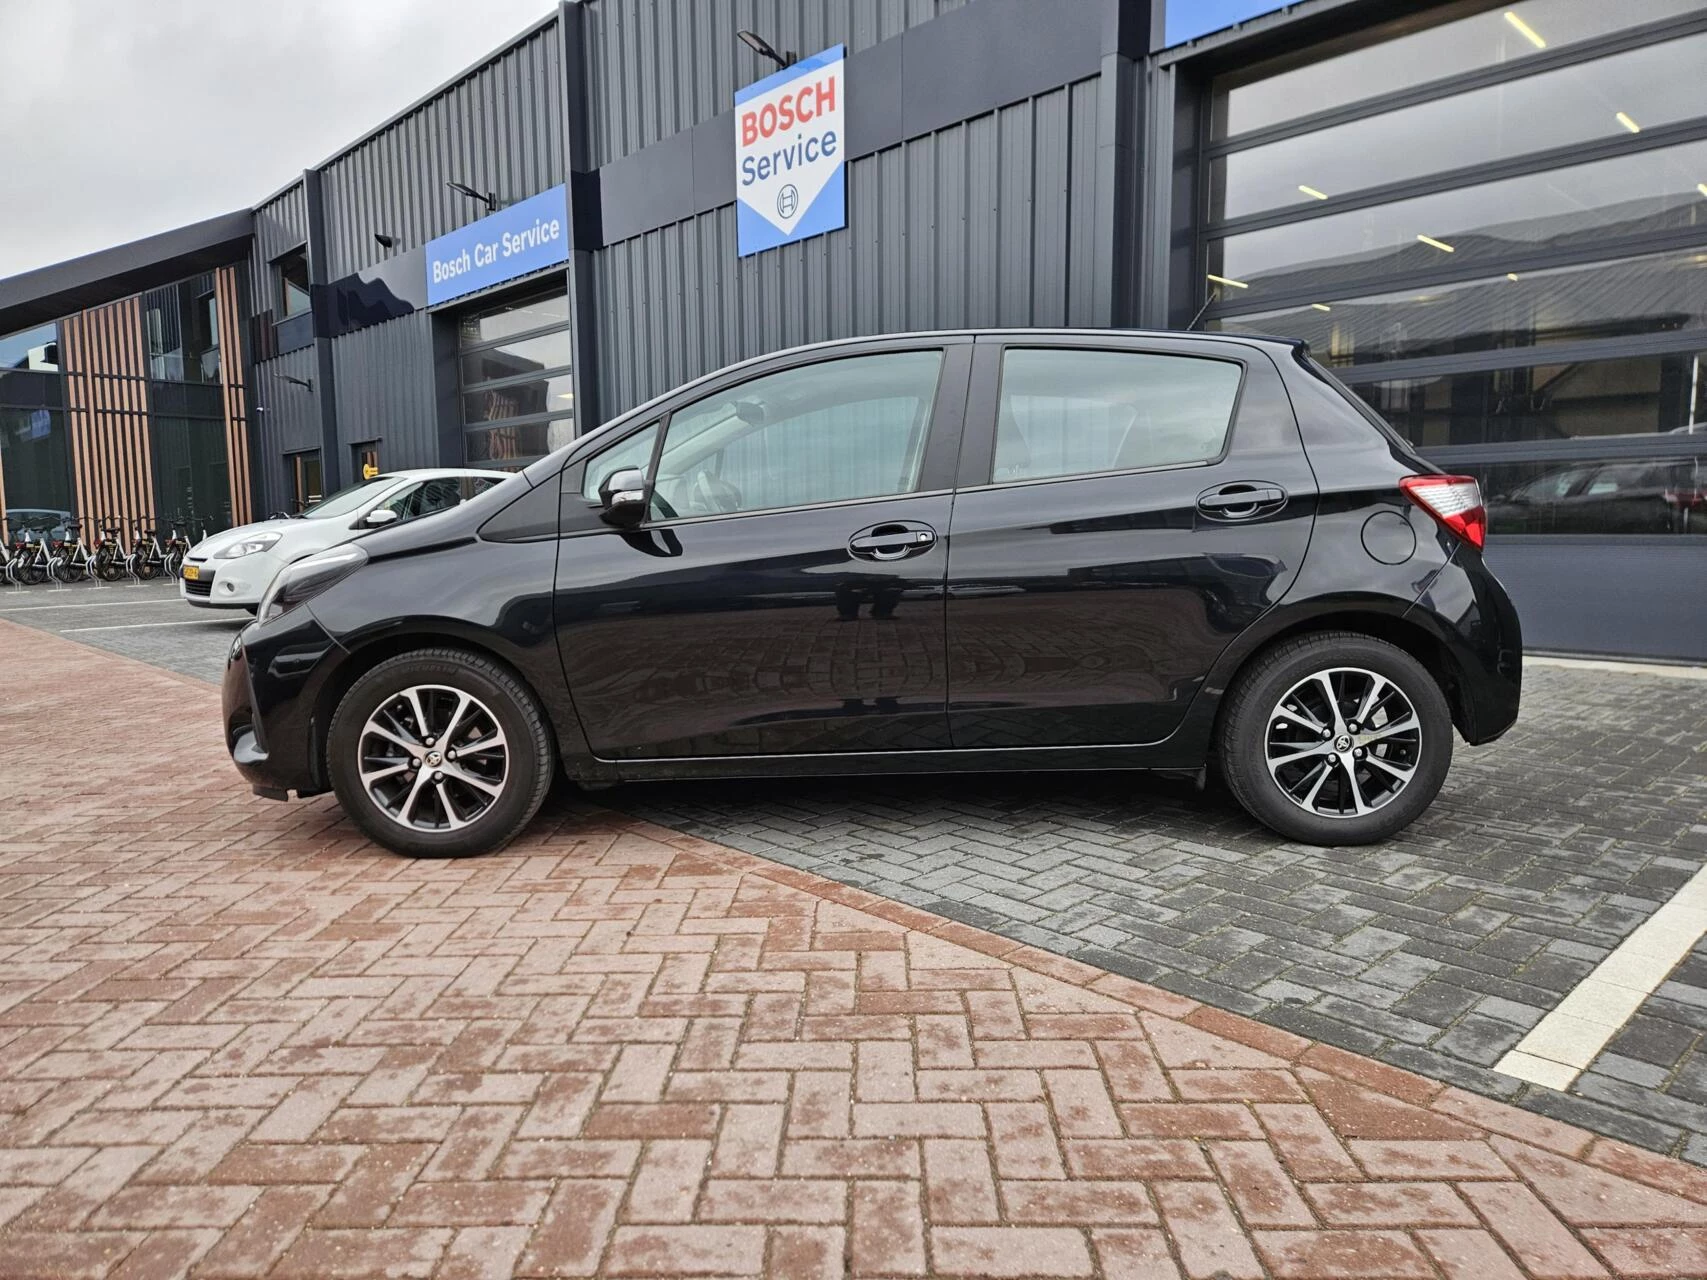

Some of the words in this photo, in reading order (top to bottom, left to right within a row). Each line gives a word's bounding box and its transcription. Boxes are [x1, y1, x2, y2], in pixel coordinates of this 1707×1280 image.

[741, 76, 836, 147] BOSCH
[742, 130, 837, 187] Service
[433, 248, 471, 284] Bosch
[474, 242, 499, 268] Car
[502, 218, 560, 257] Service
